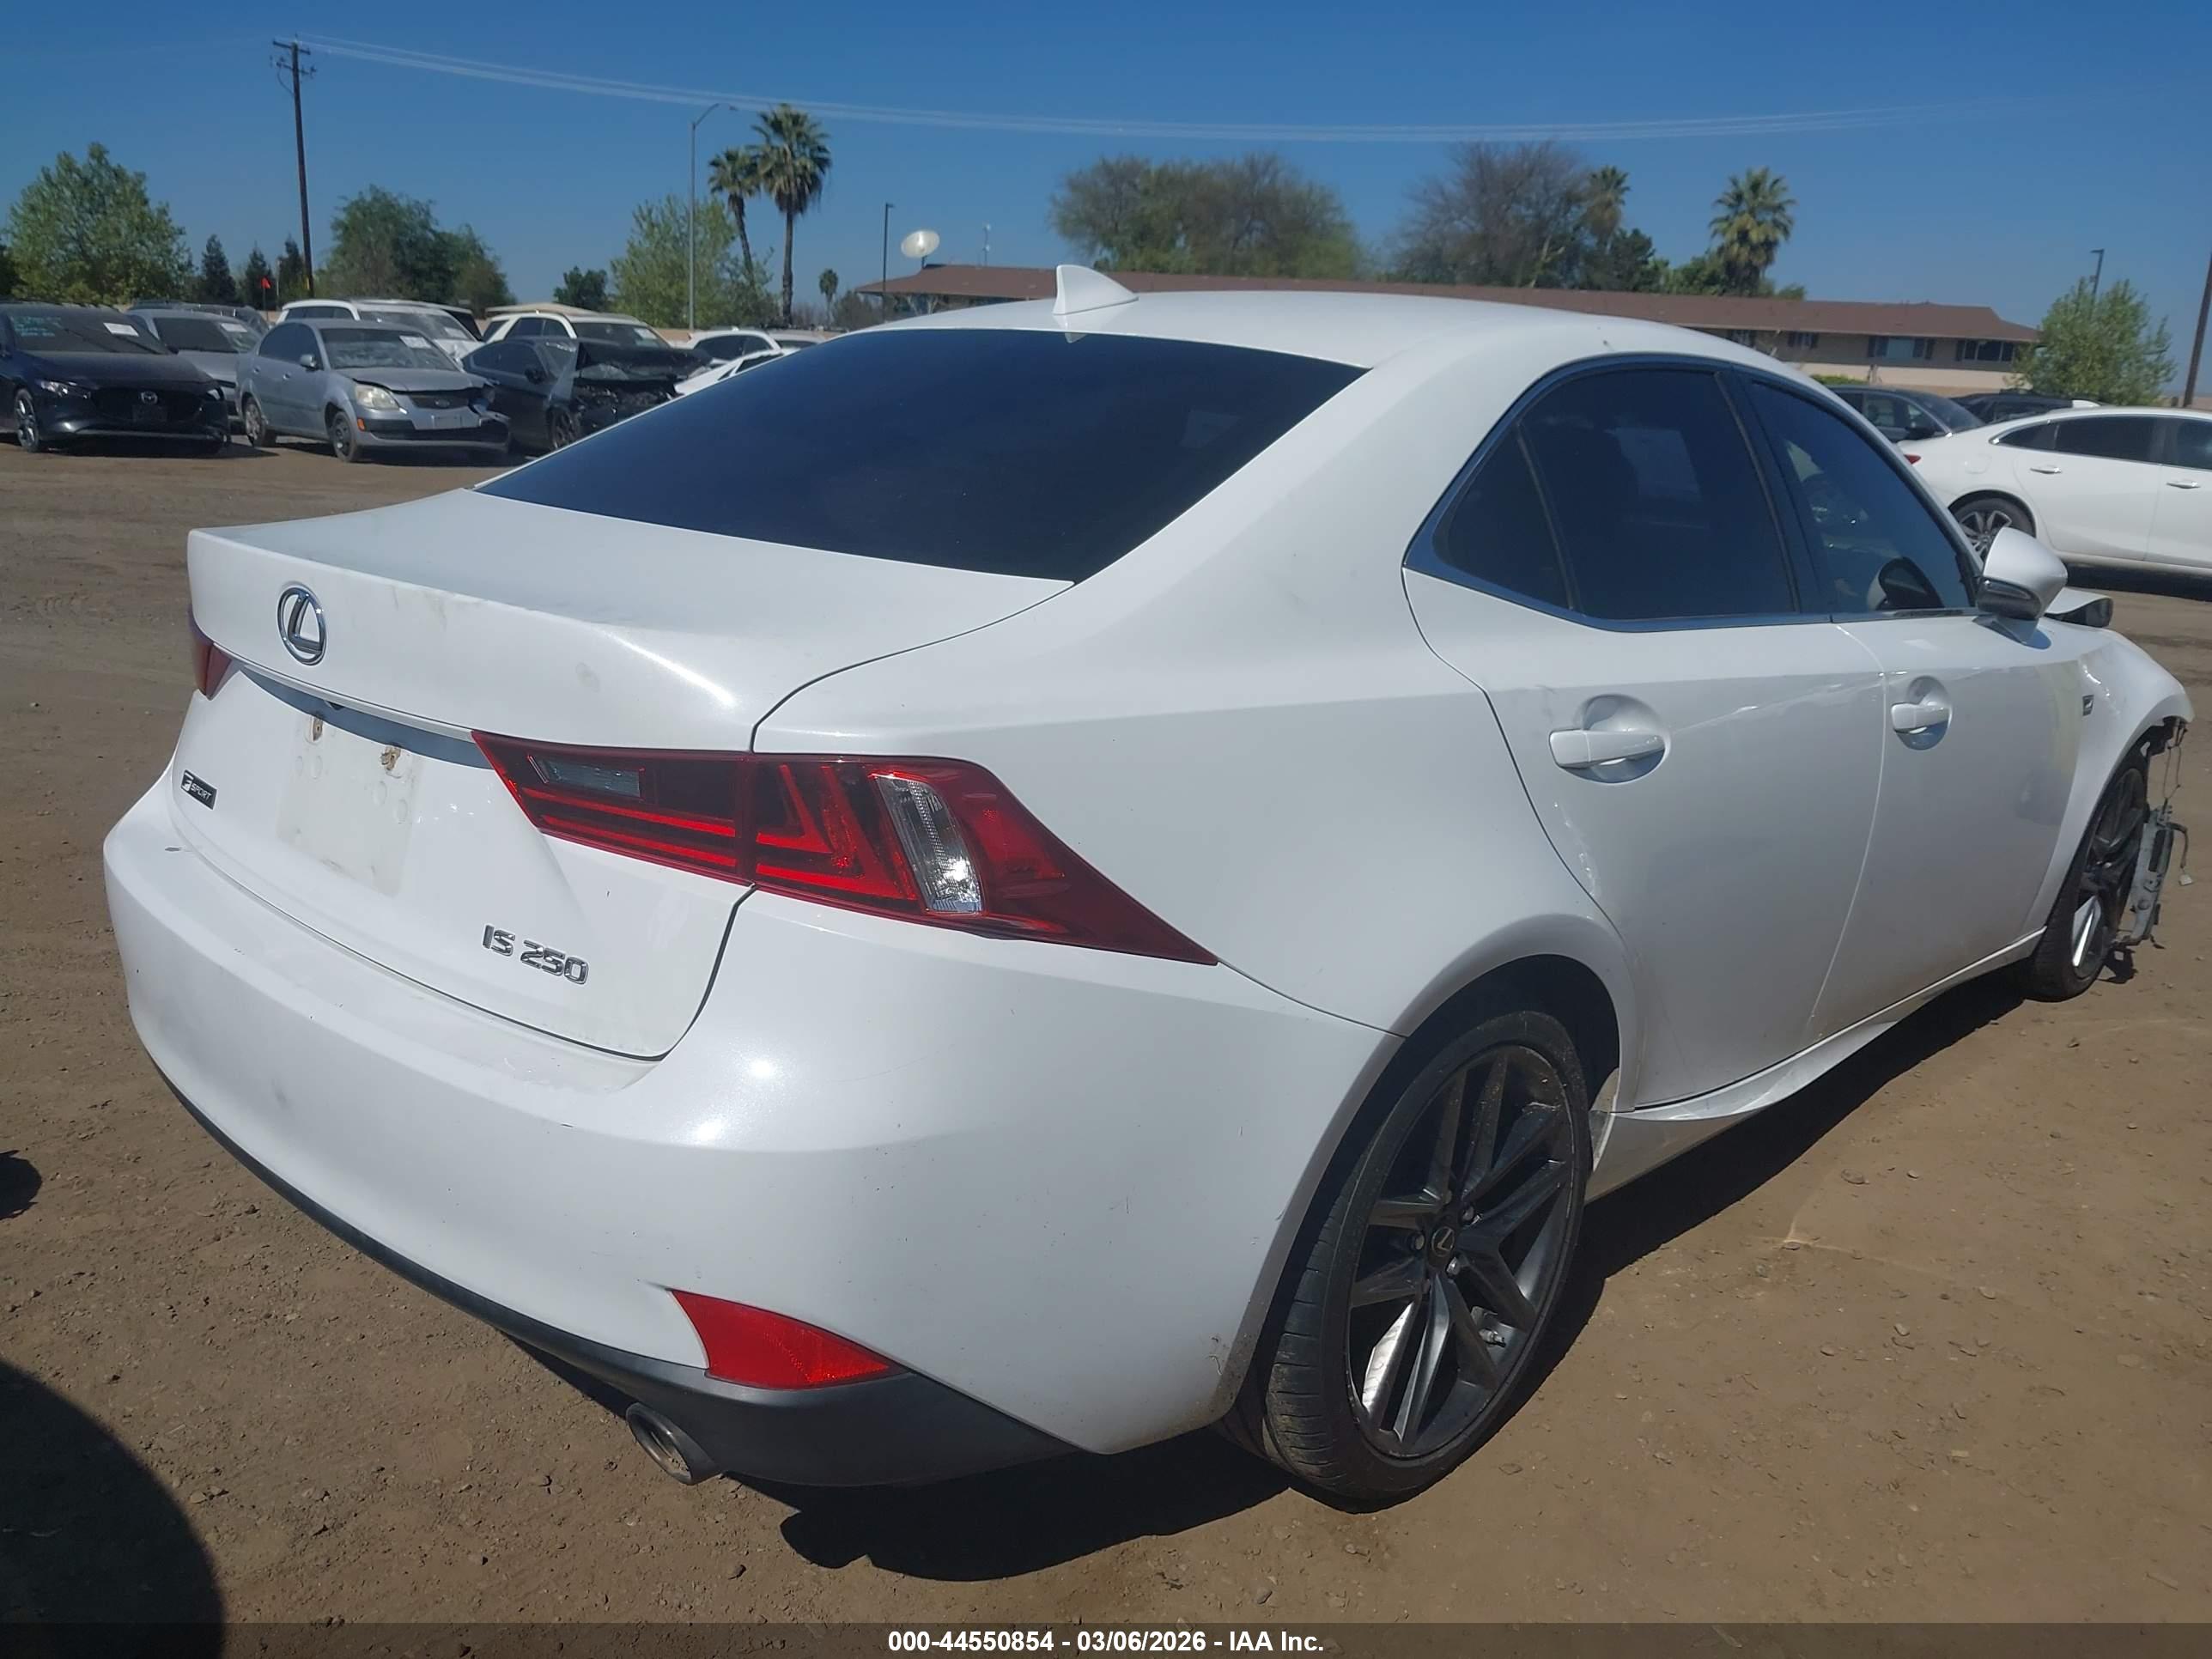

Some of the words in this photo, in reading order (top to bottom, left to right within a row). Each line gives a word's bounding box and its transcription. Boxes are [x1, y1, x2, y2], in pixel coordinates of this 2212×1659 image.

[191, 782, 212, 800] SPORT
[482, 924, 516, 957] IS
[520, 939, 589, 985] 250
